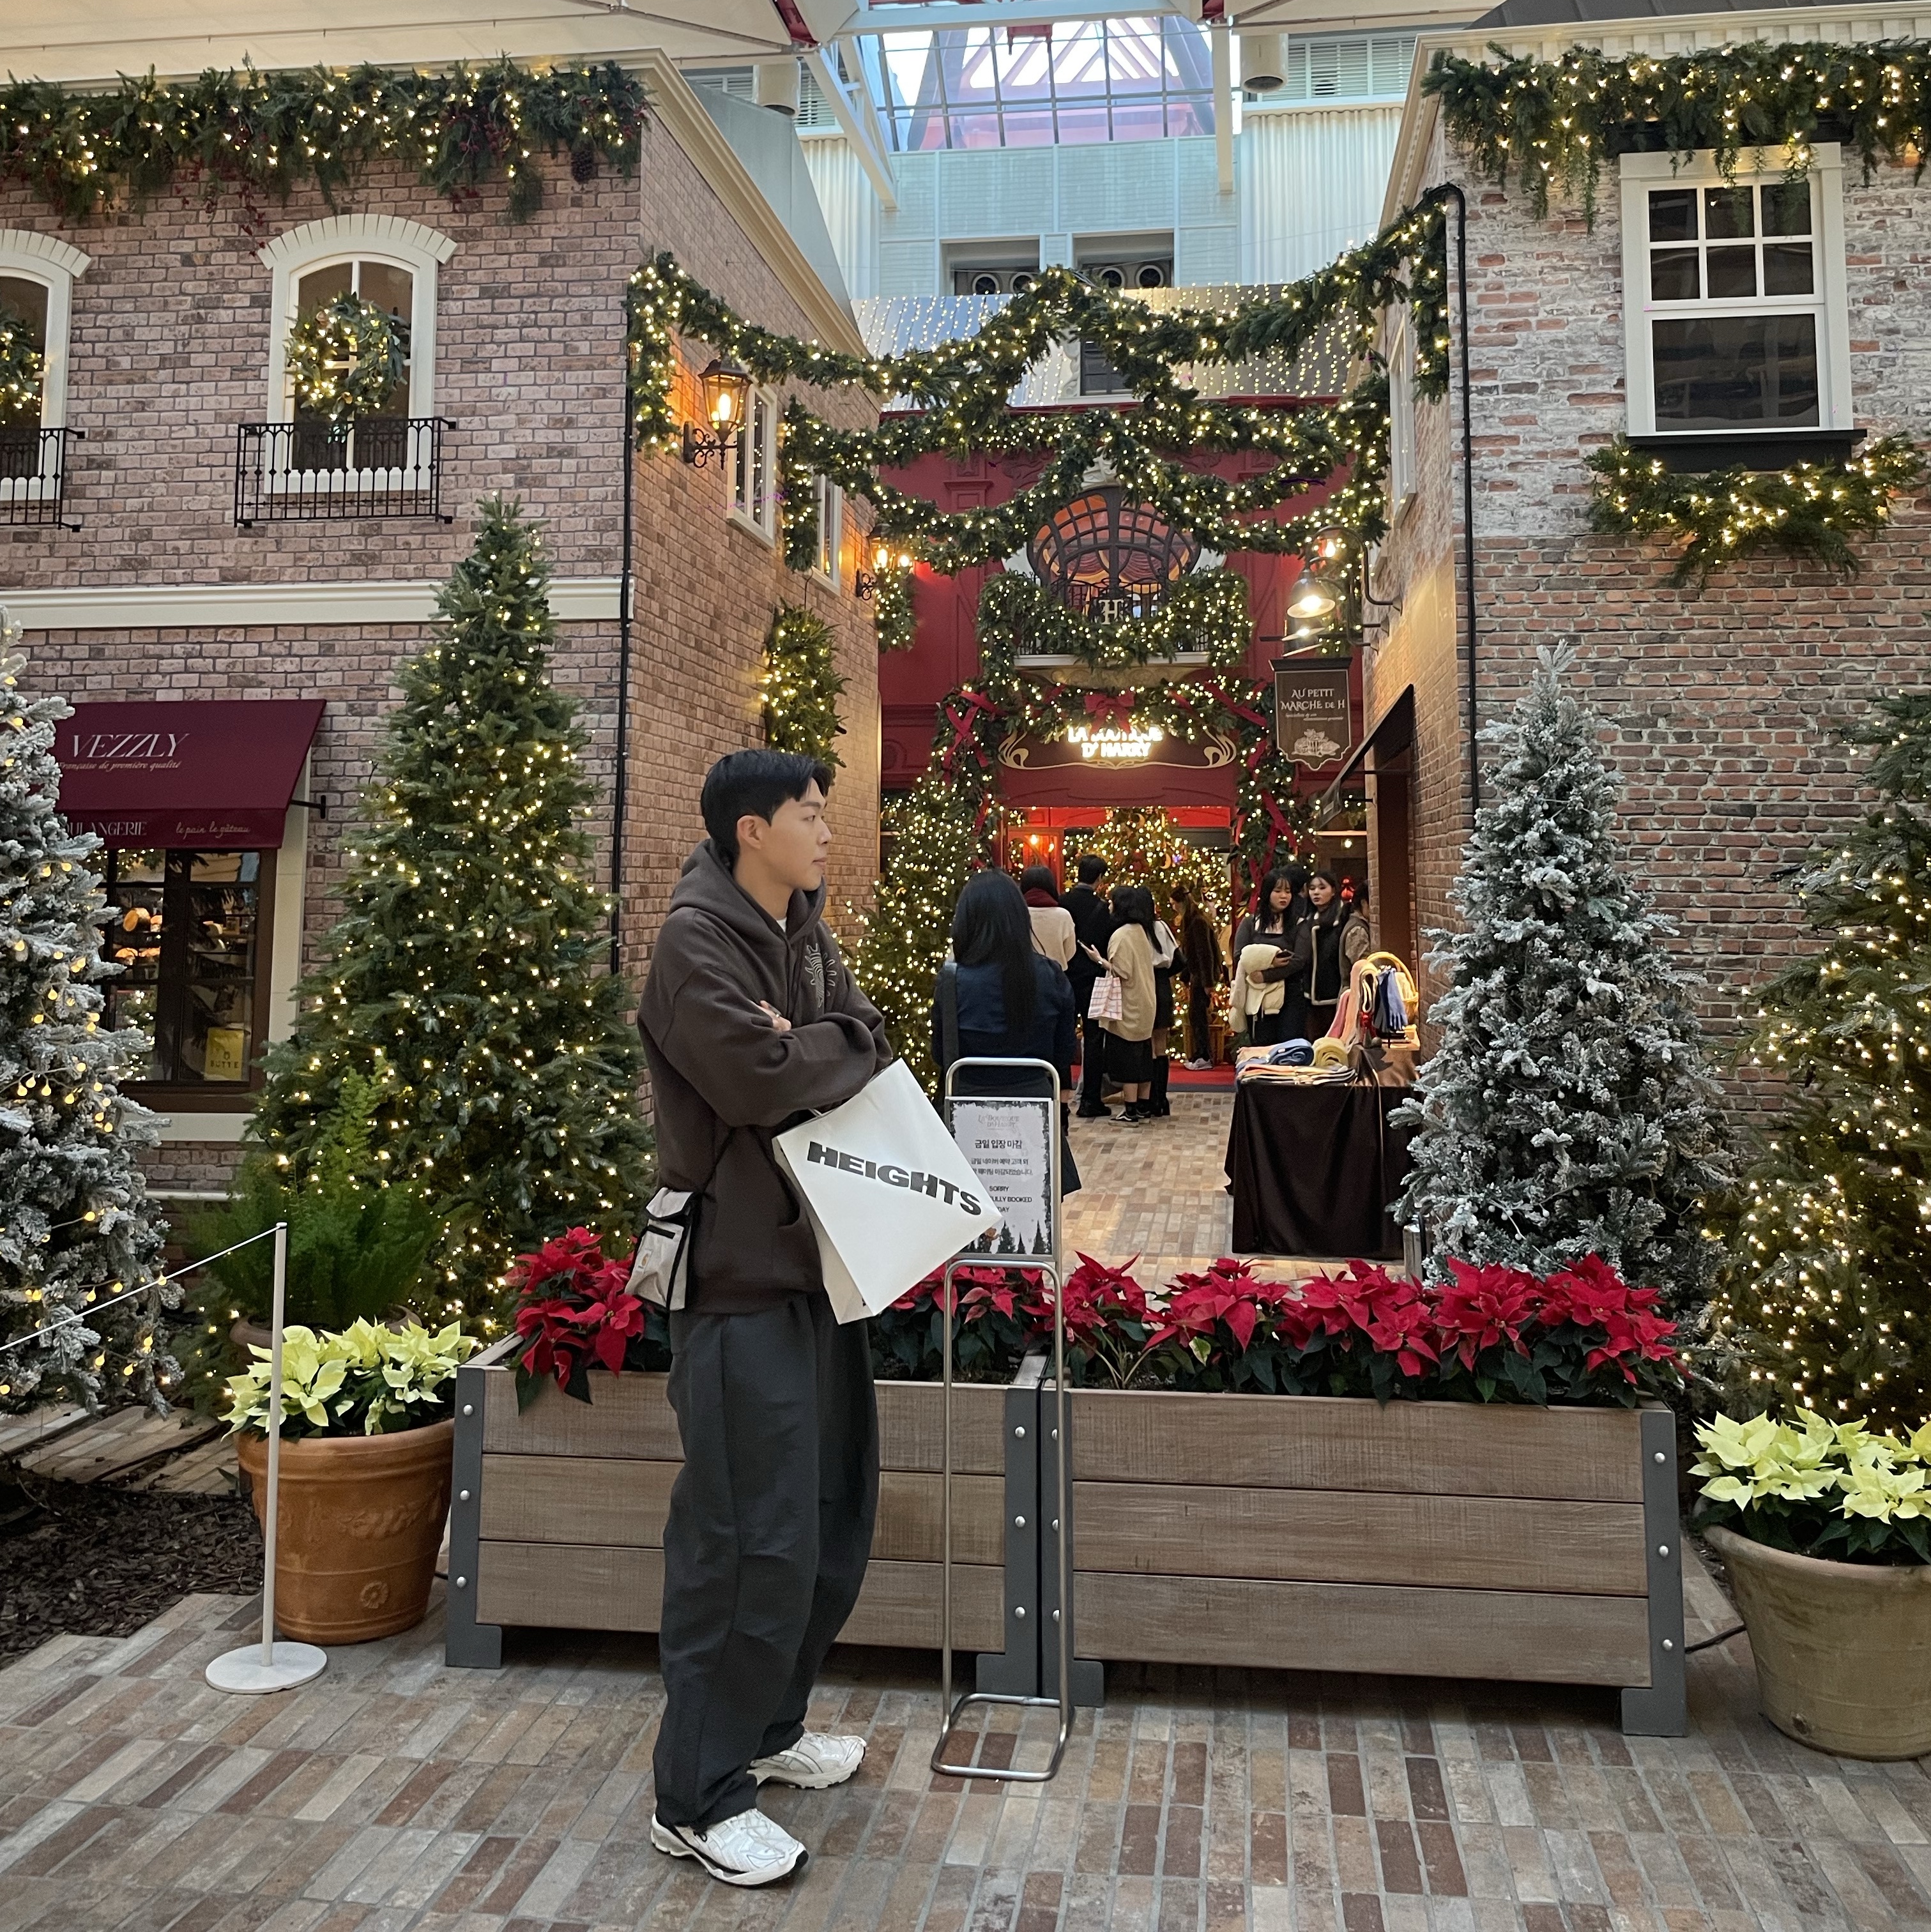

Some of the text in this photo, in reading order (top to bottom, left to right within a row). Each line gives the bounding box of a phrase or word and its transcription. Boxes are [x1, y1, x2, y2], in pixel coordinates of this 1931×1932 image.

[1291, 688, 1306, 699] AU
[1280, 700, 1322, 711] MARCHE
[1338, 699, 1345, 709] H
[1068, 727, 1088, 742] LA
[73, 733, 190, 757] VEZZLY
[975, 1139, 1022, 1149] 금일 입장 마감
[807, 1141, 981, 1215] HEIGHTS
